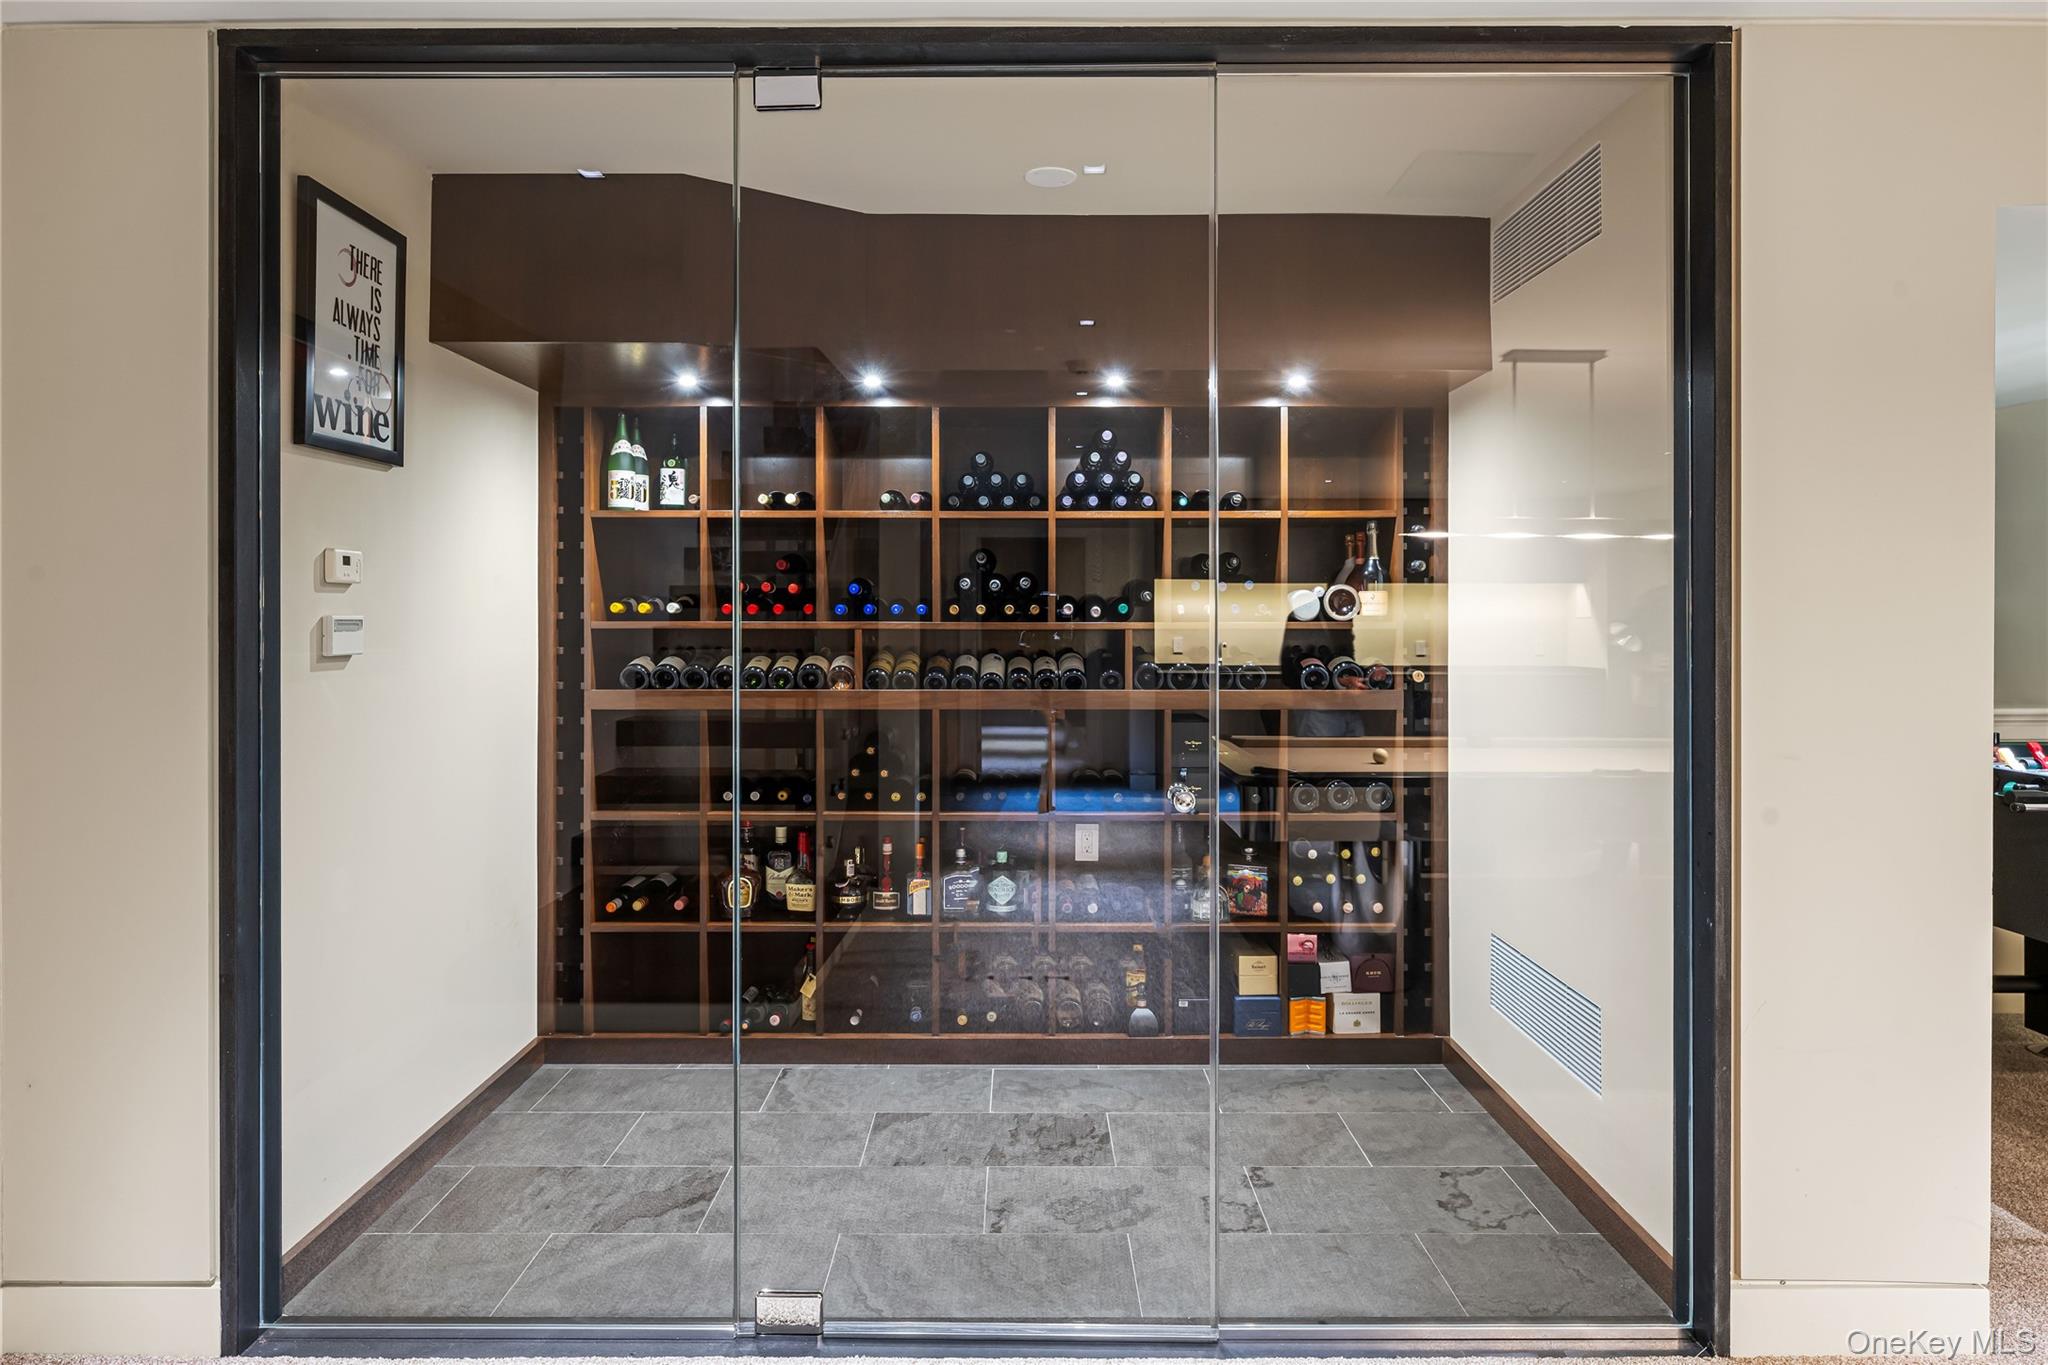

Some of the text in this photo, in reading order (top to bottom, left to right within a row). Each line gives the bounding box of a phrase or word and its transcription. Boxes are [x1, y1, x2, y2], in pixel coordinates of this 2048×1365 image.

[349, 244, 383, 286] THERE
[370, 286, 382, 314] IS
[332, 297, 381, 342] ALWAYS
[353, 335, 381, 370] TIME
[358, 365, 381, 398] FOR
[313, 390, 390, 443] wine
